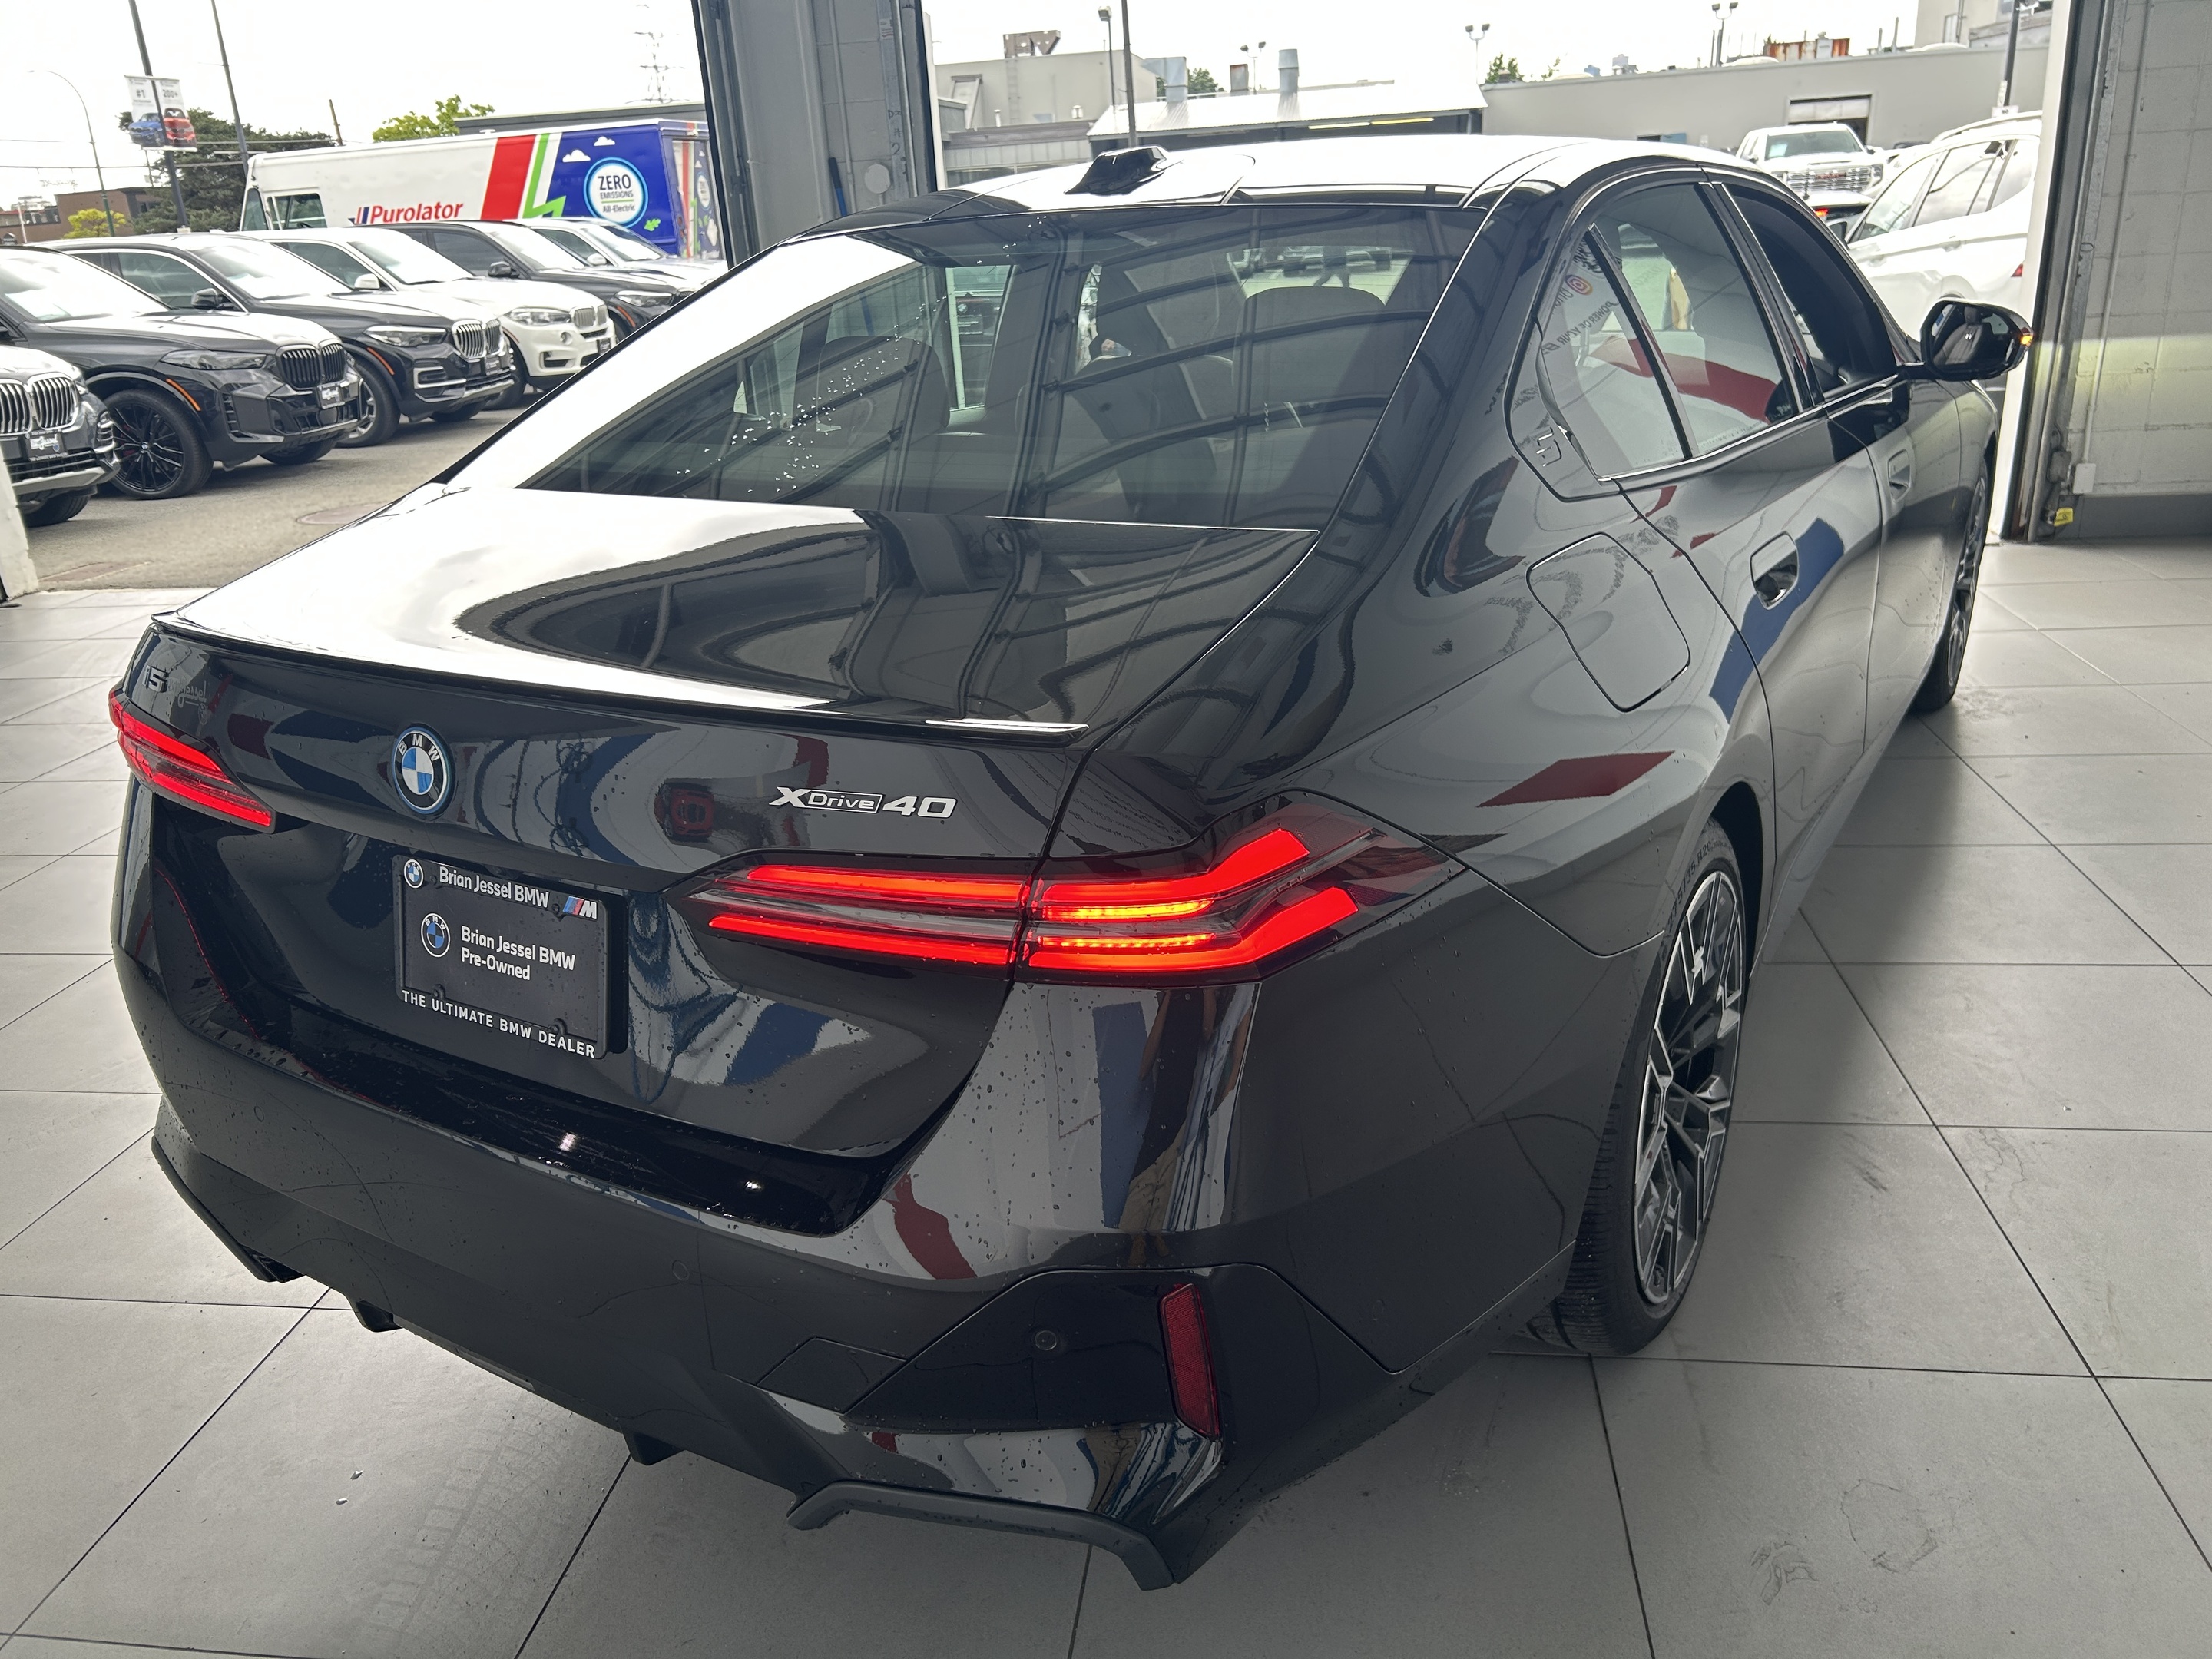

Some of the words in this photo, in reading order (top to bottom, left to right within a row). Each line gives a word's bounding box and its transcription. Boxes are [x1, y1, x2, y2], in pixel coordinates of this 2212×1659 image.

[598, 174, 631, 190] ZERO
[600, 190, 634, 199] EMISSIONS
[370, 201, 463, 224] Purolator
[398, 733, 440, 761] BMW
[439, 866, 472, 889] Brian
[474, 875, 512, 899] Jessel
[515, 886, 550, 908] BMW
[461, 926, 495, 950] Brian
[496, 935, 536, 961] Jessel
[539, 946, 575, 971] BMW
[461, 946, 531, 981] Pre-Owned
[402, 989, 426, 1008] THE
[432, 998, 493, 1028] ULTIMATE
[499, 1018, 531, 1039] BMW
[538, 1030, 595, 1058] DEALER
